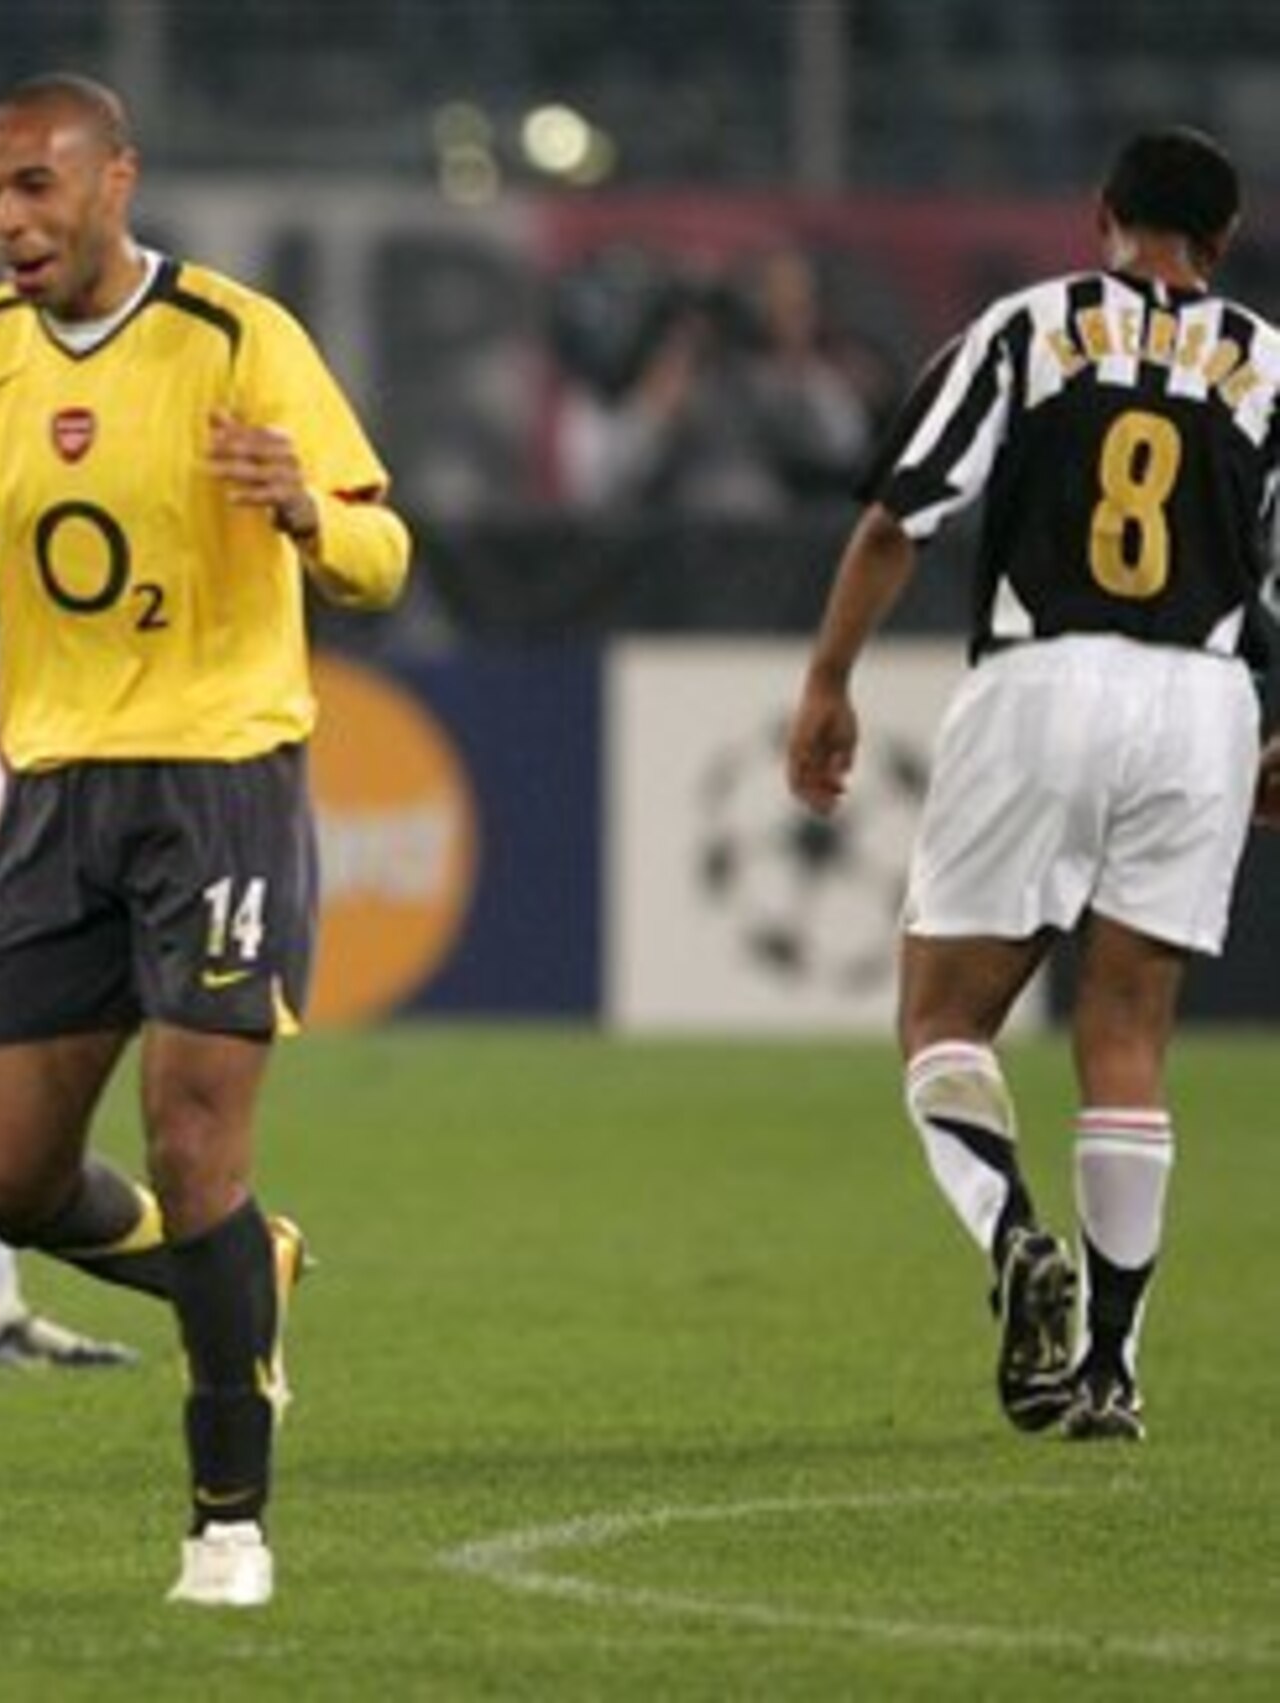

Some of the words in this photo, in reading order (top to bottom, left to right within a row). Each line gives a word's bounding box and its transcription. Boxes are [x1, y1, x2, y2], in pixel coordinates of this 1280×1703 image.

[34, 500, 169, 634] O2
[1090, 409, 1182, 597] 8
[203, 876, 267, 960] 14
